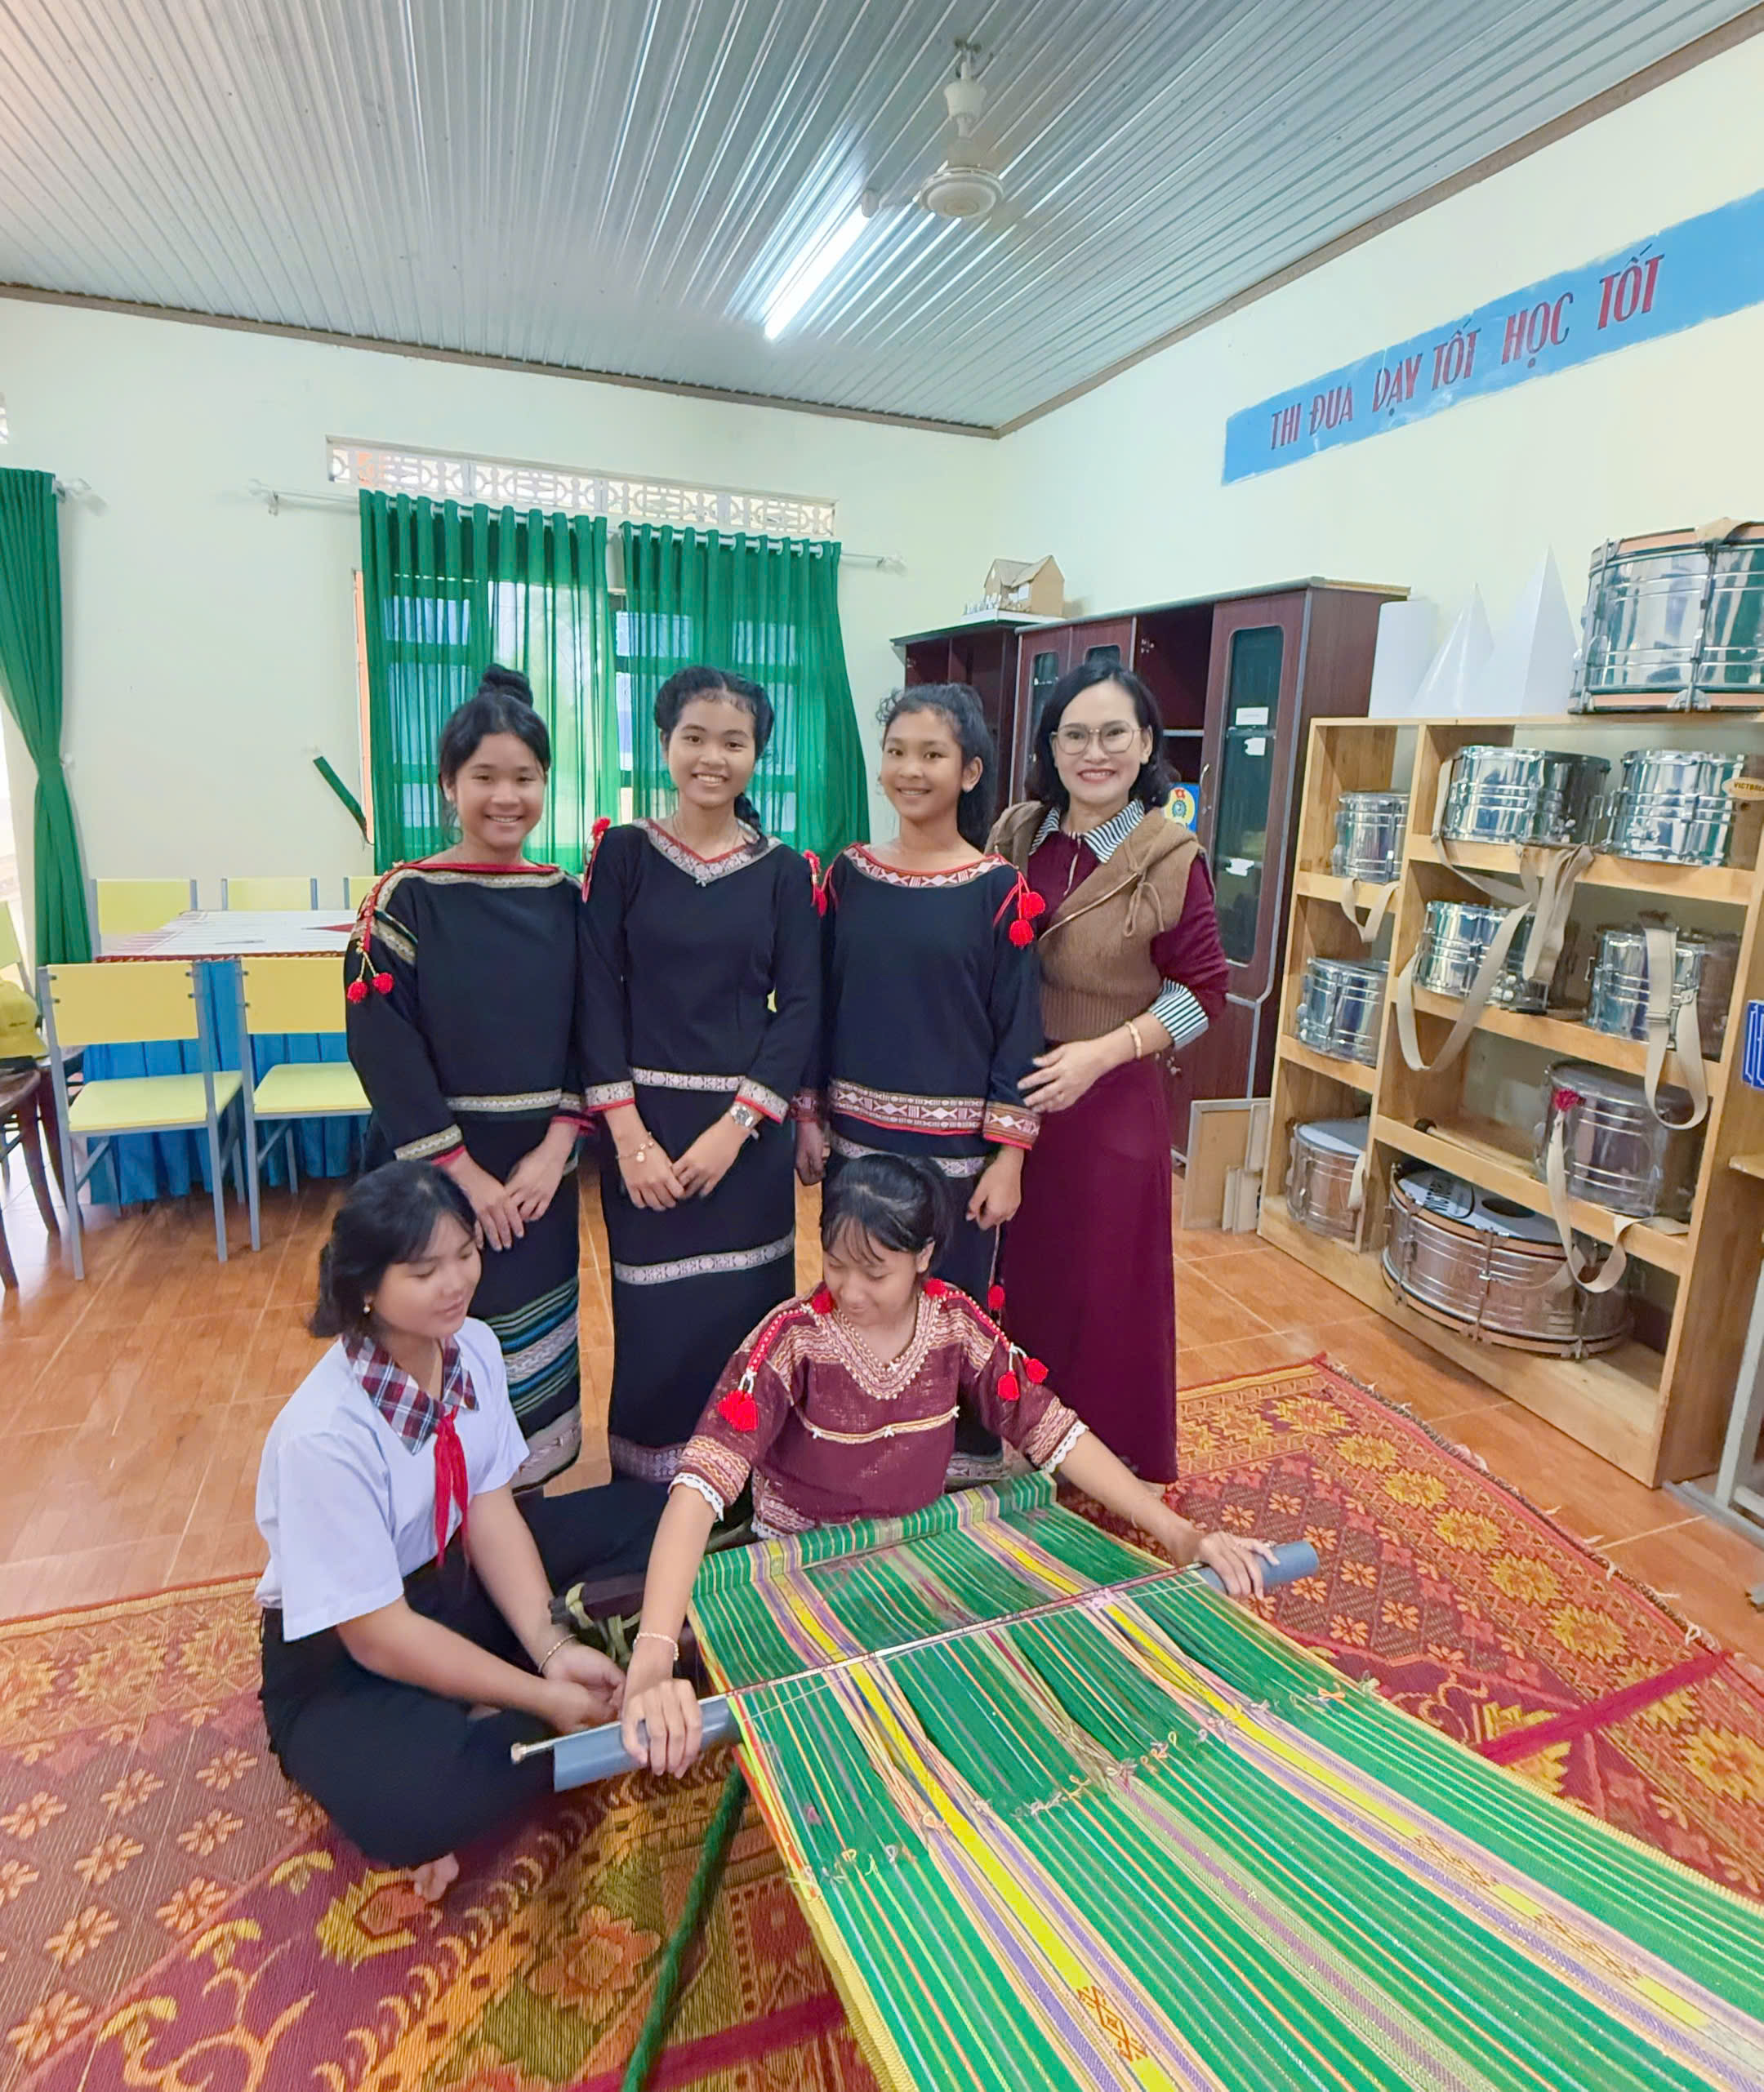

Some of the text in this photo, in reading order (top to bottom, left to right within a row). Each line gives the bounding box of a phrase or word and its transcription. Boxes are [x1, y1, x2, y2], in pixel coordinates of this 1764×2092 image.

[1271, 243, 1665, 450] THI ĐUA DẠY TỐT HỌC TỐT
